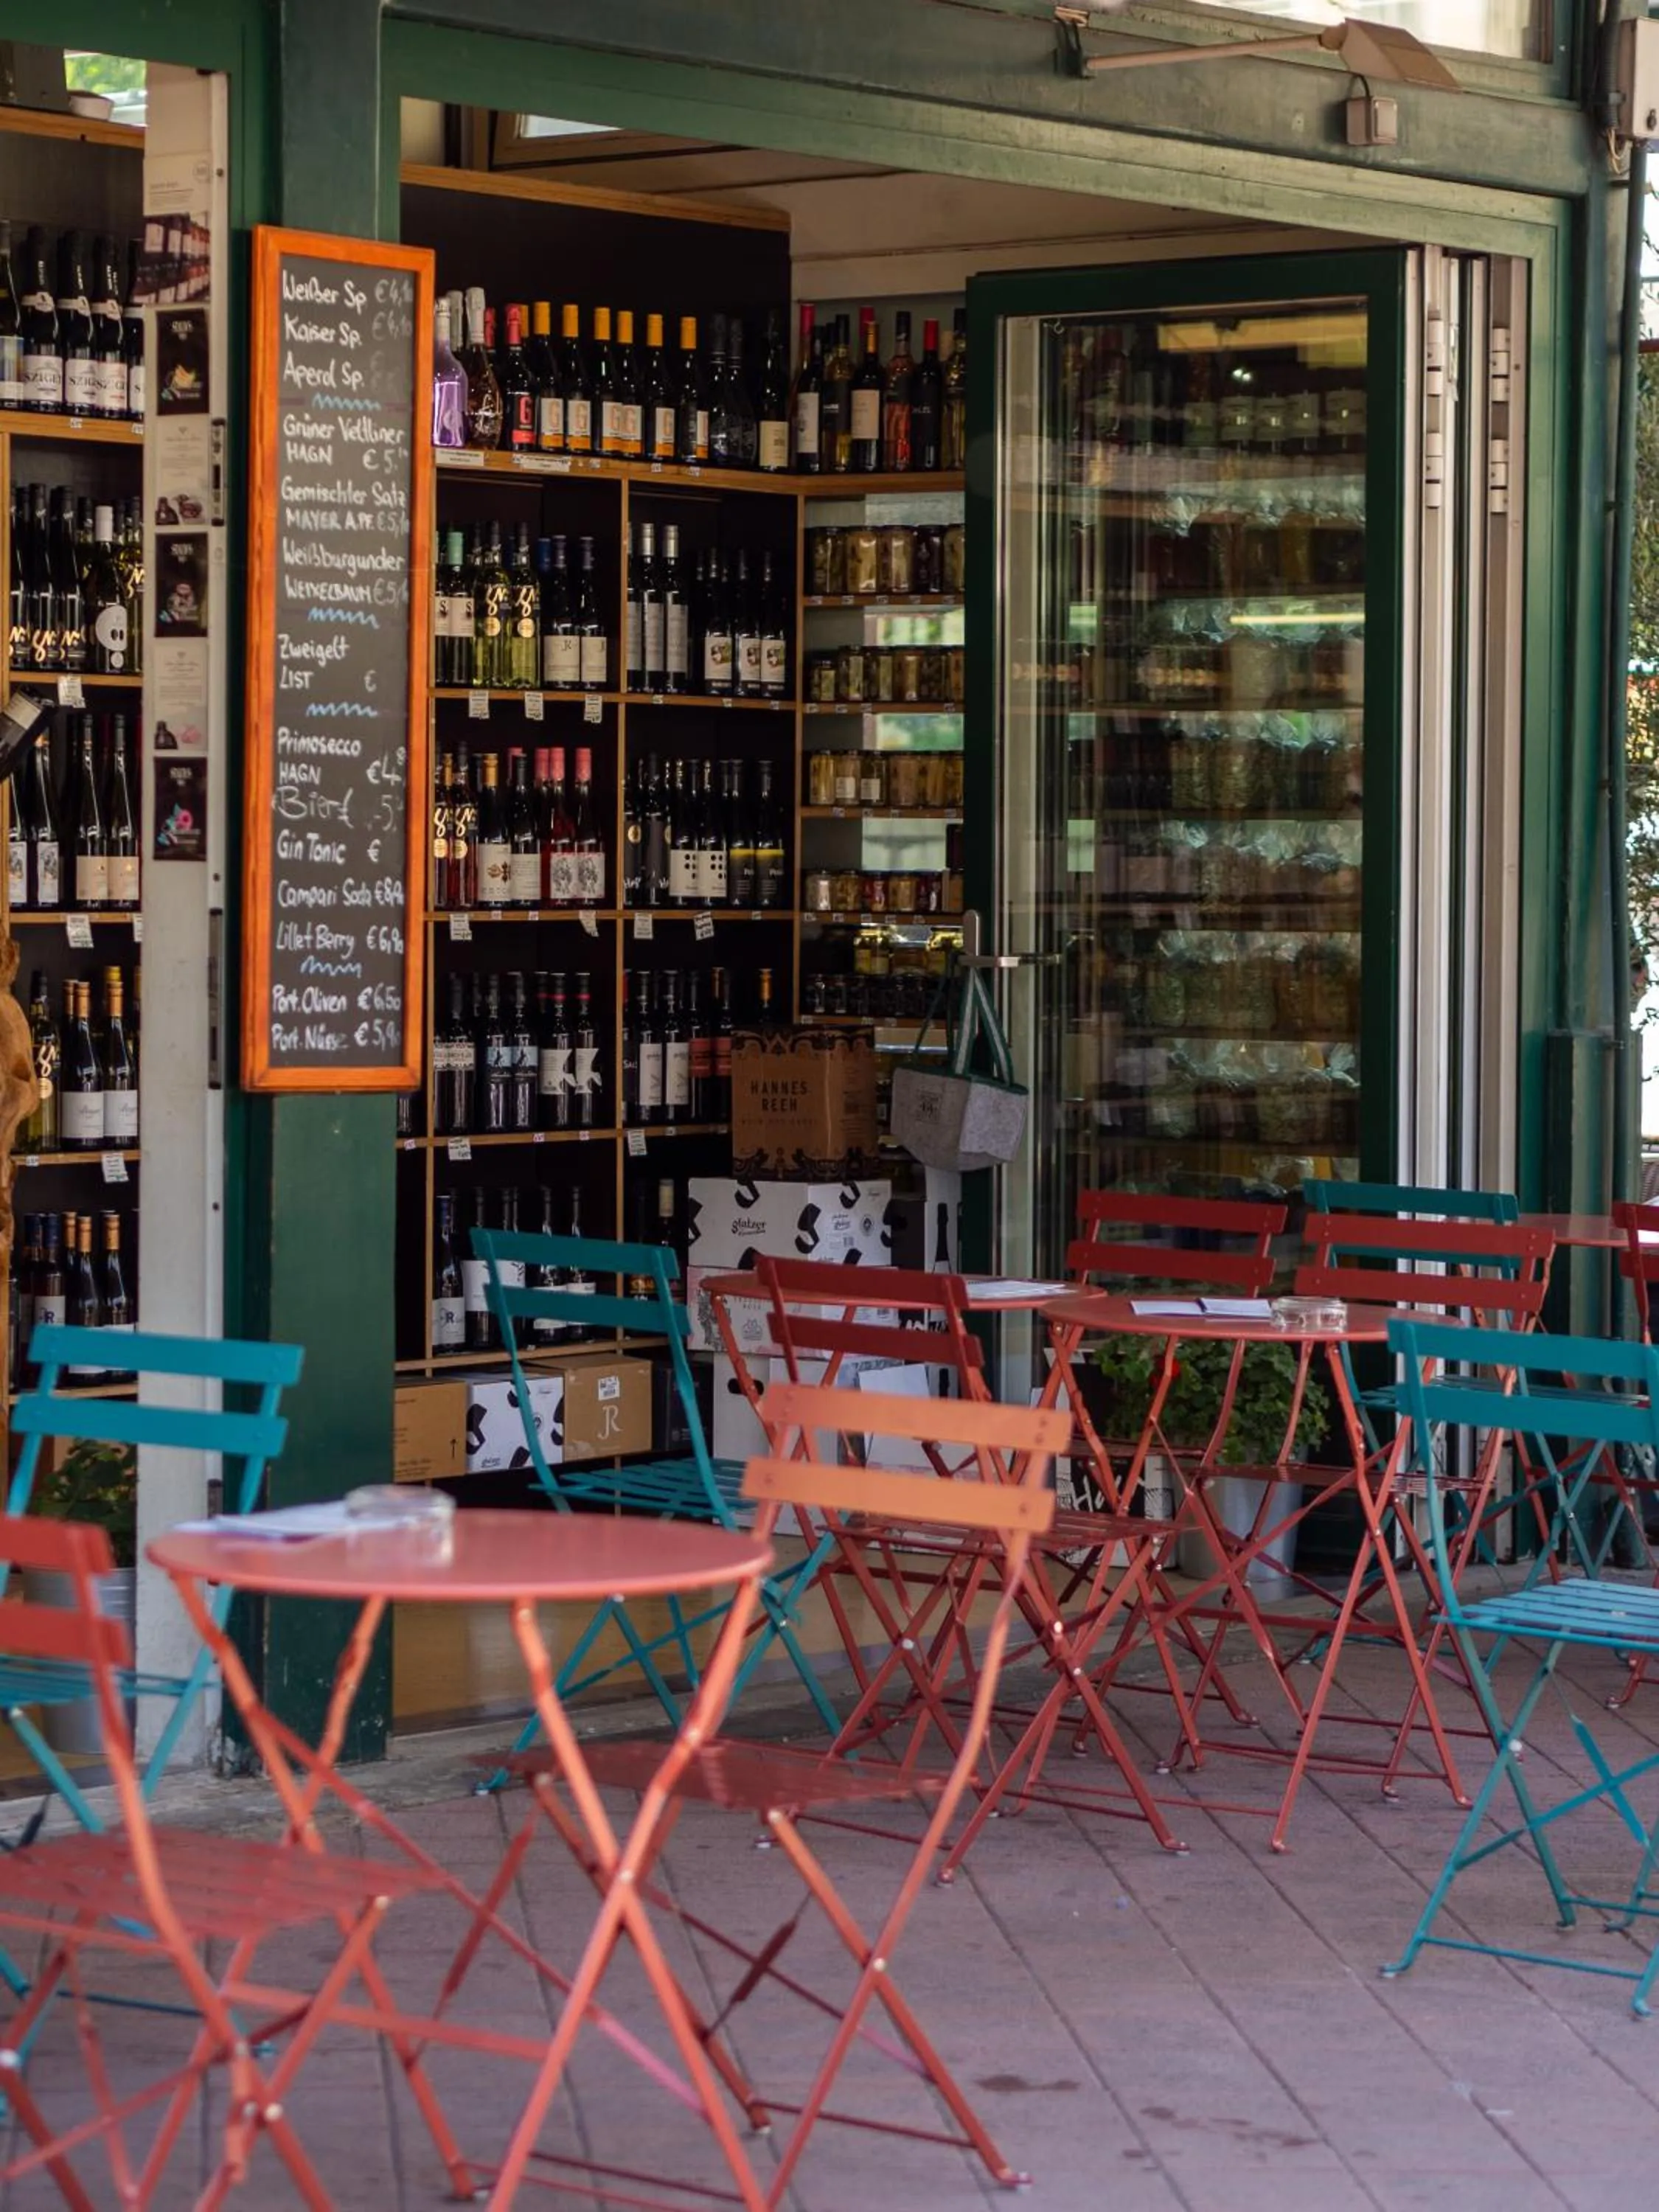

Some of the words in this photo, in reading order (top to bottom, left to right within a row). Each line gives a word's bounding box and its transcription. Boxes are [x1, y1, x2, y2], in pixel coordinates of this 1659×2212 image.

[283, 269, 339, 304] Weißer
[285, 313, 335, 342] Kaiser
[283, 413, 335, 439] Grüner
[338, 416, 404, 444] Veltliner
[286, 442, 332, 465] HAGN
[282, 476, 367, 504] Gemischter
[286, 507, 341, 531] MAYER
[283, 537, 405, 578] Weißburgunder
[278, 634, 349, 667] Zweigelt
[279, 666, 313, 689] LIST
[277, 726, 361, 756] Primosecco
[279, 762, 321, 784] HAGN
[277, 829, 303, 860] Gin
[307, 832, 346, 865] Tonic
[278, 880, 337, 908] Campari
[342, 877, 372, 906] Soda
[276, 921, 313, 950] Lillet
[316, 924, 355, 959] Berry
[302, 987, 347, 1014] Oliven
[750, 1080, 808, 1095] HANNES
[762, 1097, 798, 1113] REEH
